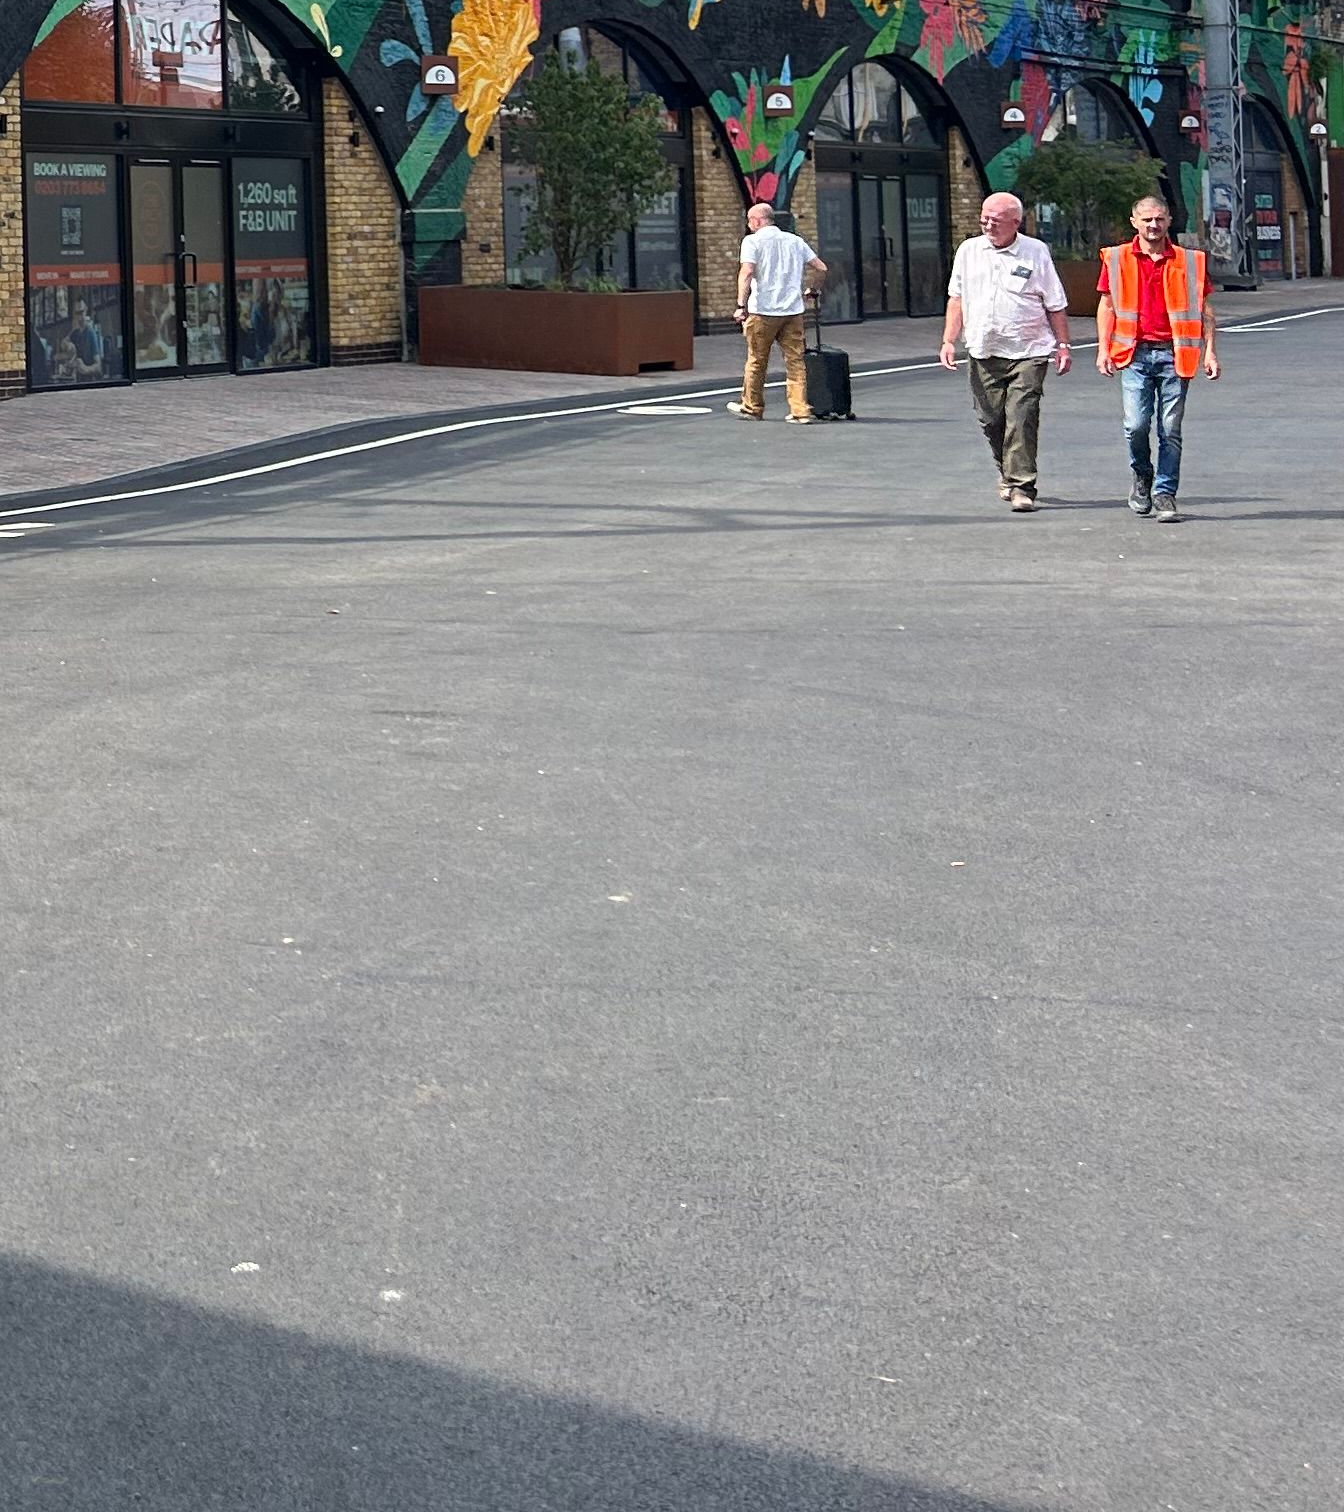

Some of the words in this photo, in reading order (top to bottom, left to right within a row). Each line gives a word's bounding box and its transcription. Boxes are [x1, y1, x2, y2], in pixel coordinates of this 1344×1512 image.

[434, 68, 446, 83] 6
[775, 96, 784, 107] 5
[33, 162, 60, 177] BOOK
[60, 162, 68, 177] A
[67, 162, 107, 177] VIEWING
[238, 182, 272, 208] 1,260
[273, 189, 288, 208] sq
[288, 183, 298, 205] ft
[919, 198, 938, 218] LET
[239, 210, 265, 232] F&B
[266, 210, 298, 232] UNIT
